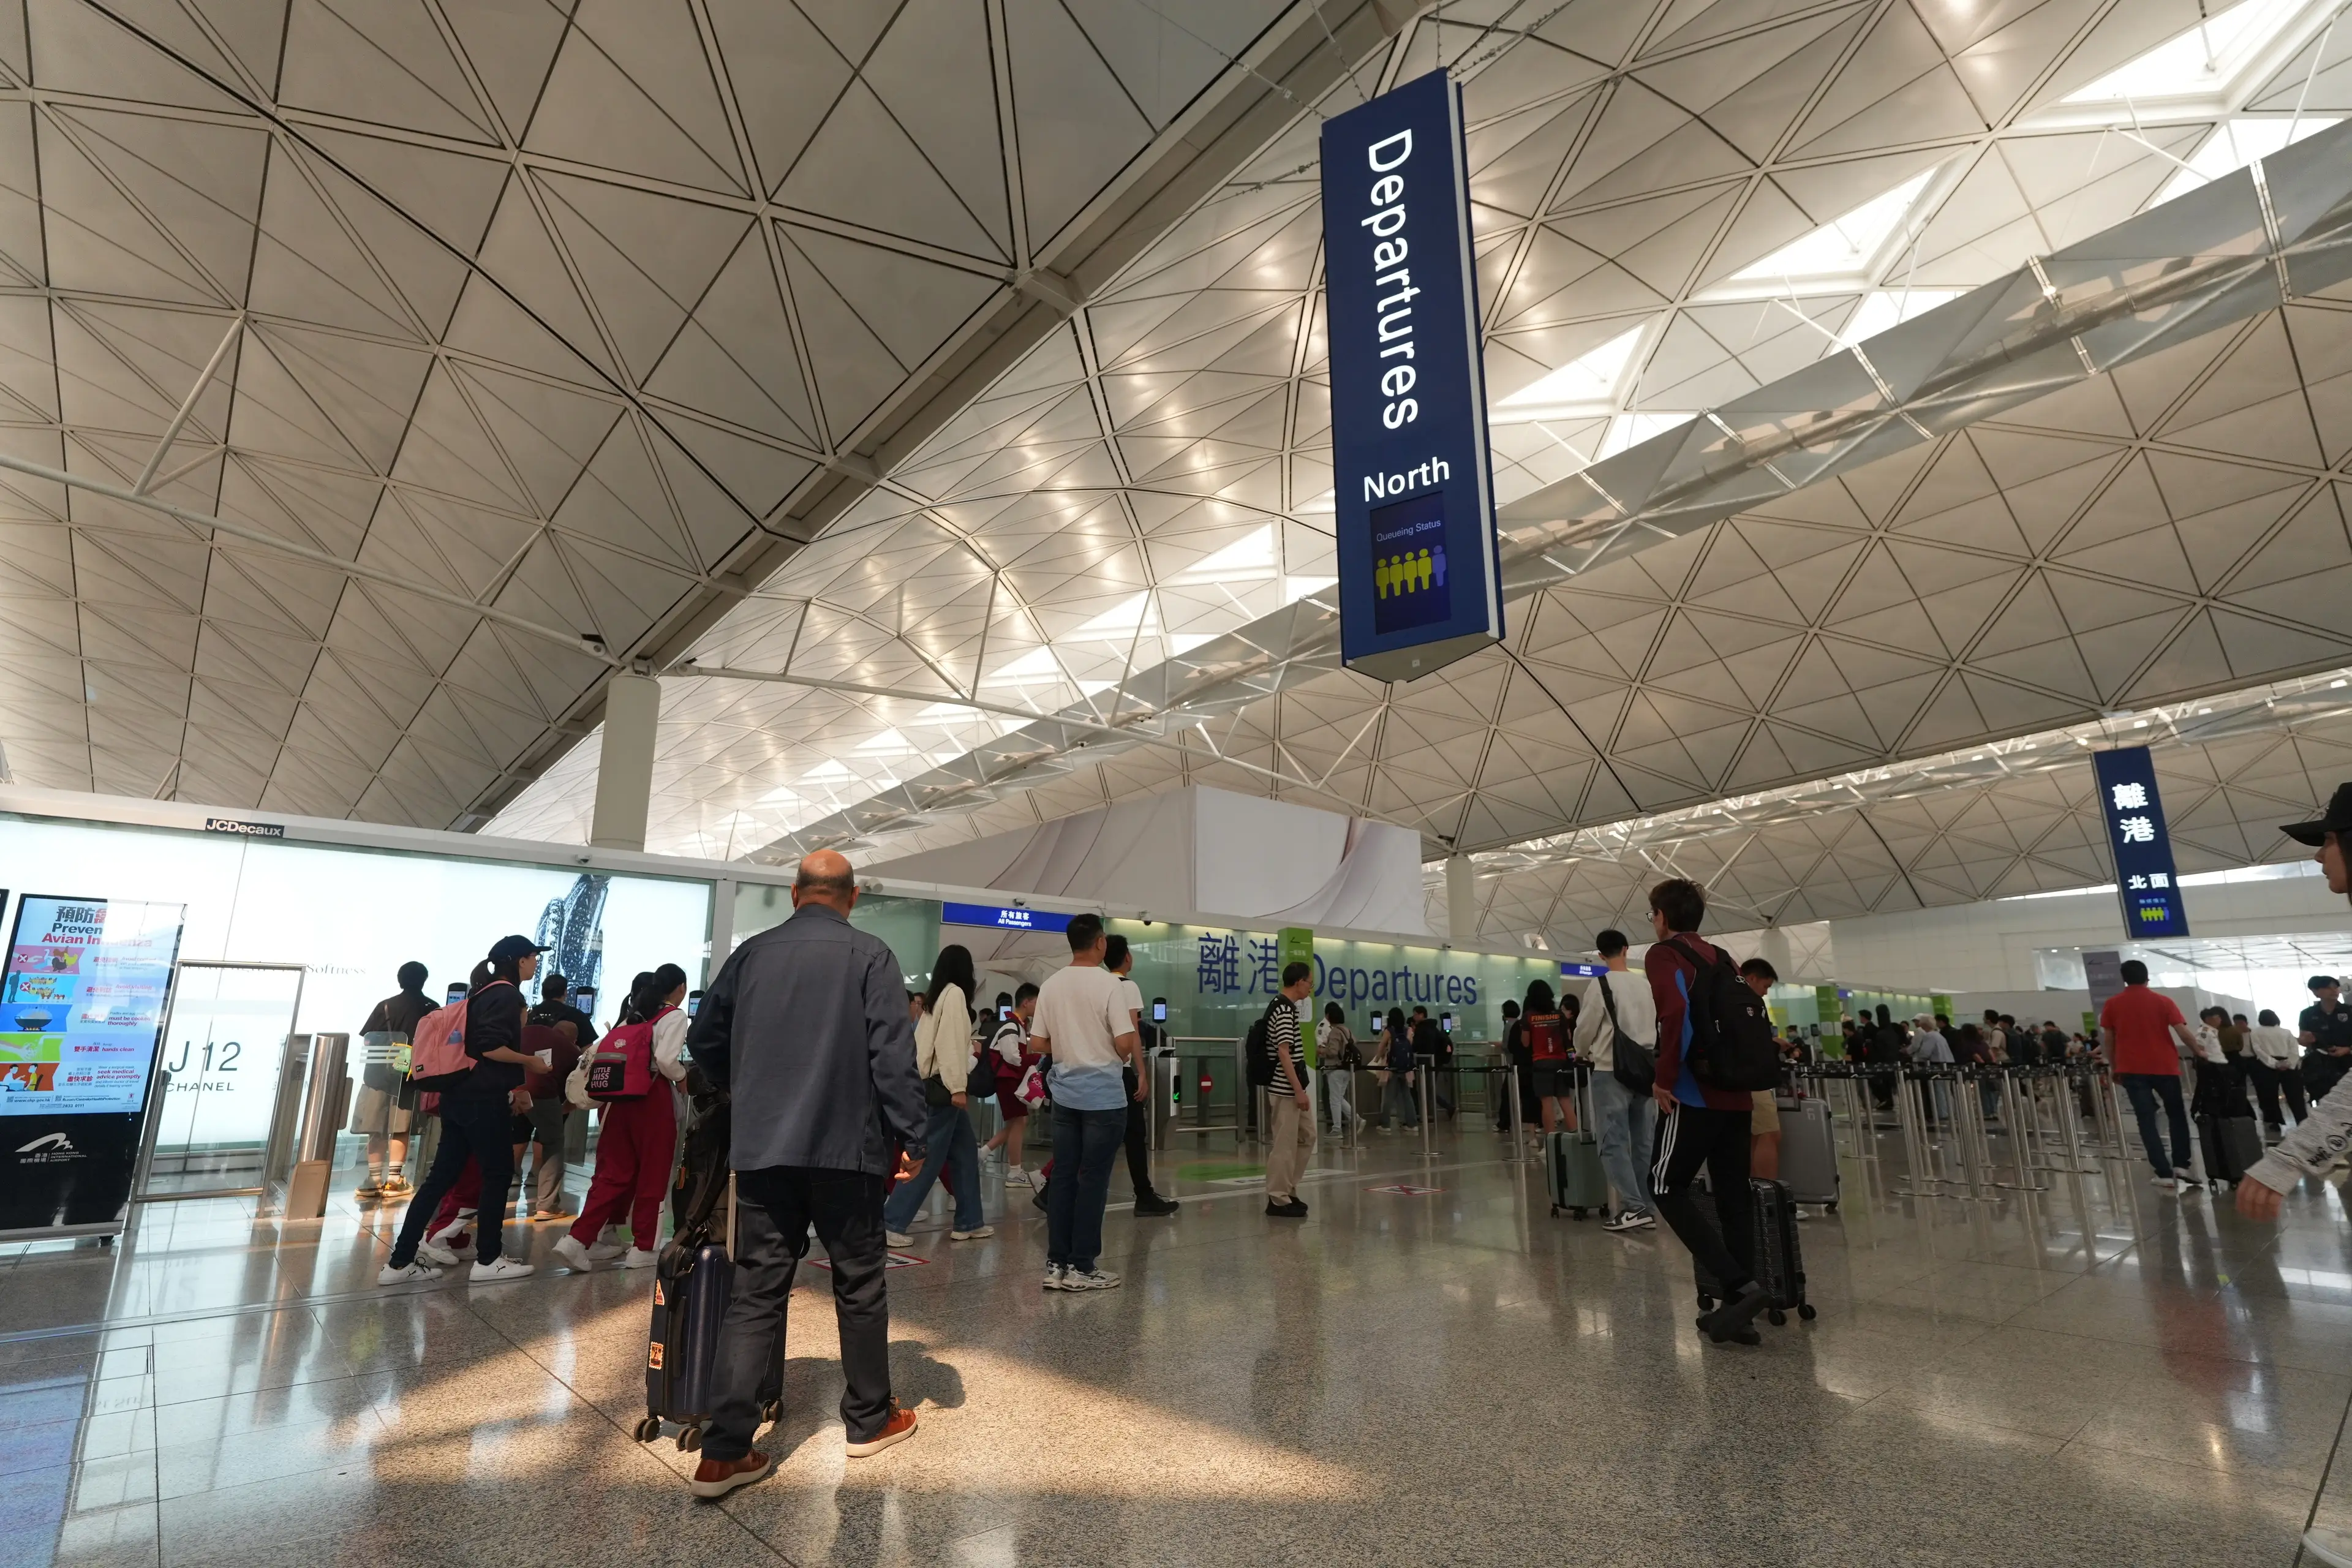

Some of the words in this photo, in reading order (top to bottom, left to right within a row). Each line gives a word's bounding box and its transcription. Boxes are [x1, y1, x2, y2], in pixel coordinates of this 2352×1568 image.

[1361, 129, 1421, 430] Departures
[1363, 456, 1450, 502] North
[1376, 524, 1414, 542] Queueing
[1415, 519, 1441, 532] Status
[2112, 783, 2155, 843] 離港
[206, 820, 281, 836] JCDecaux
[2128, 873, 2169, 889] 北面
[52, 922, 104, 934] Preven
[42, 933, 85, 944] Avian
[306, 963, 367, 974] Softness
[1197, 932, 1278, 995] 離港
[167, 1082, 235, 1091] CHANEL
